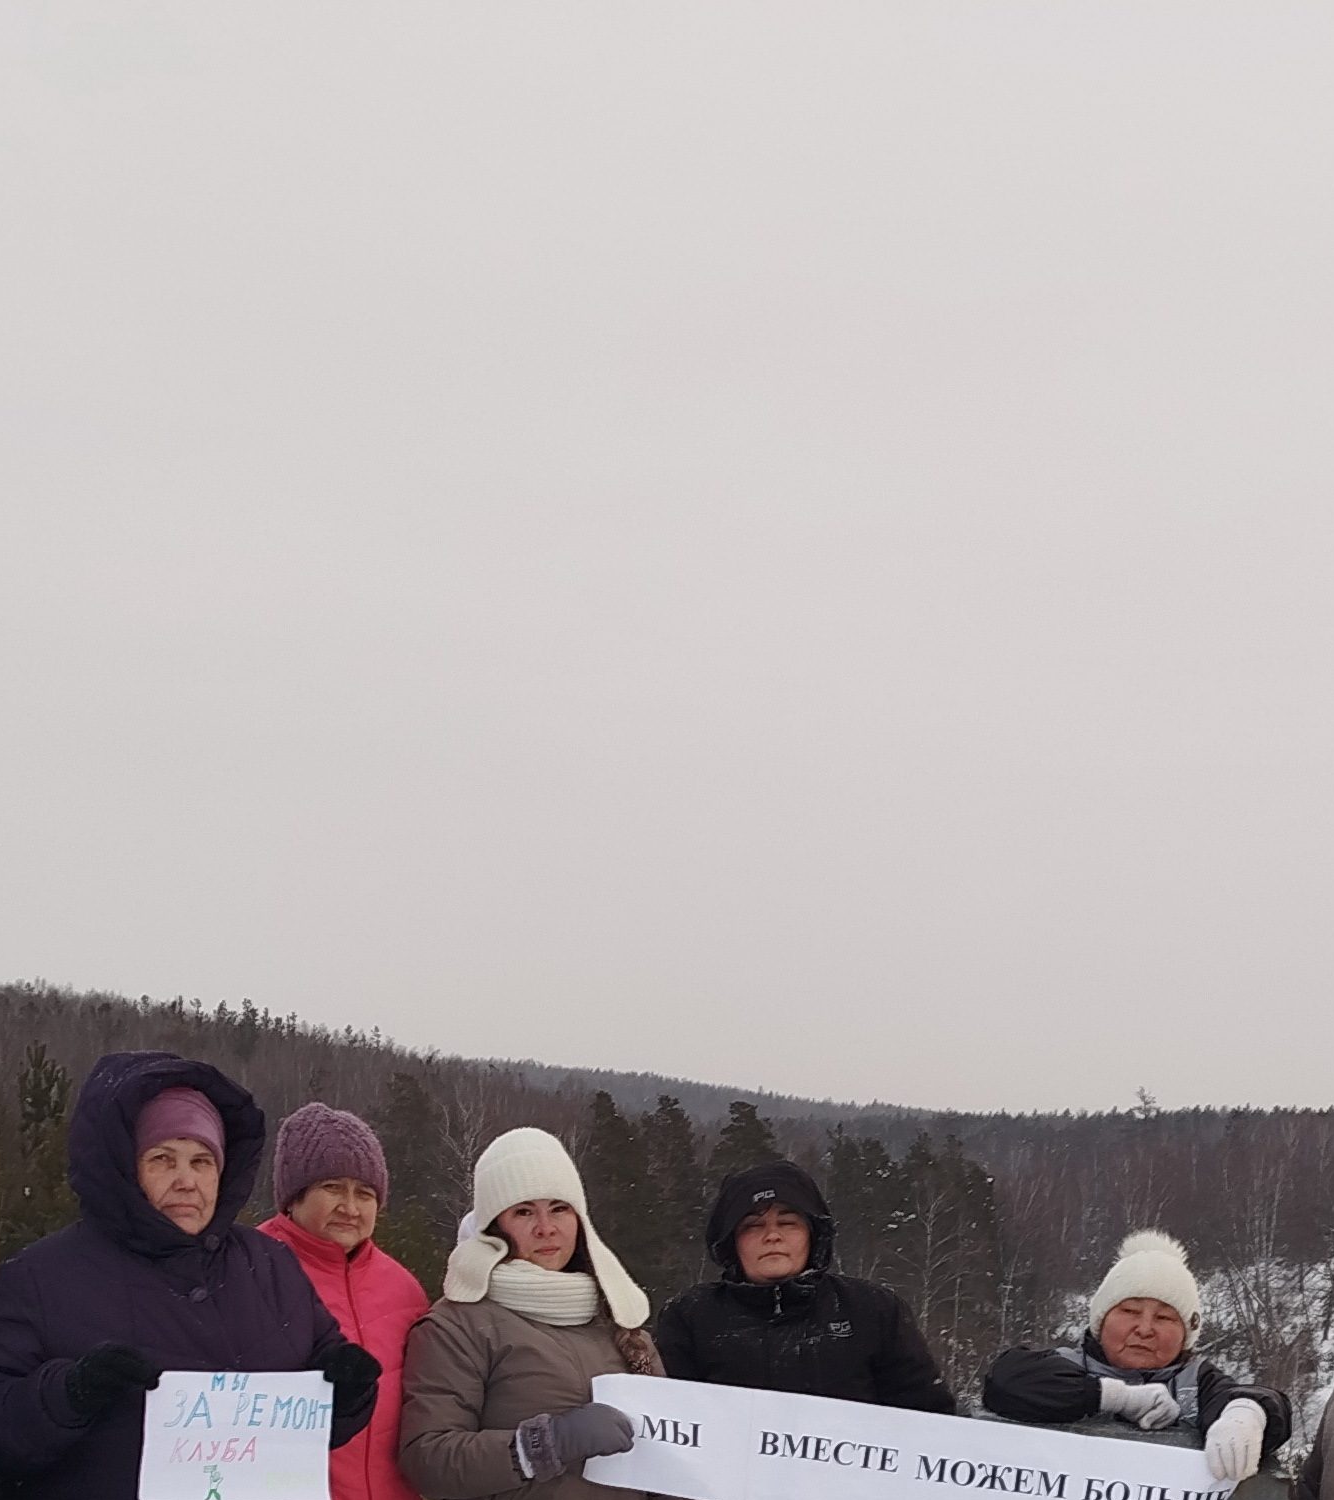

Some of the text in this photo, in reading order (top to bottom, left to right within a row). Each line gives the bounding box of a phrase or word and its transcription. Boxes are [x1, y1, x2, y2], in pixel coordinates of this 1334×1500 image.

[753, 1190, 776, 1202] PG
[829, 1321, 851, 1332] PG
[211, 1373, 249, 1391] МЫ
[164, 1391, 332, 1430] ЗА РЕМОНТ
[170, 1436, 257, 1463] КЛУБА
[639, 1414, 702, 1448] МЫ
[758, 1431, 899, 1473] ВМЕСТЕ
[914, 1455, 1070, 1499] МОЖЕМ
